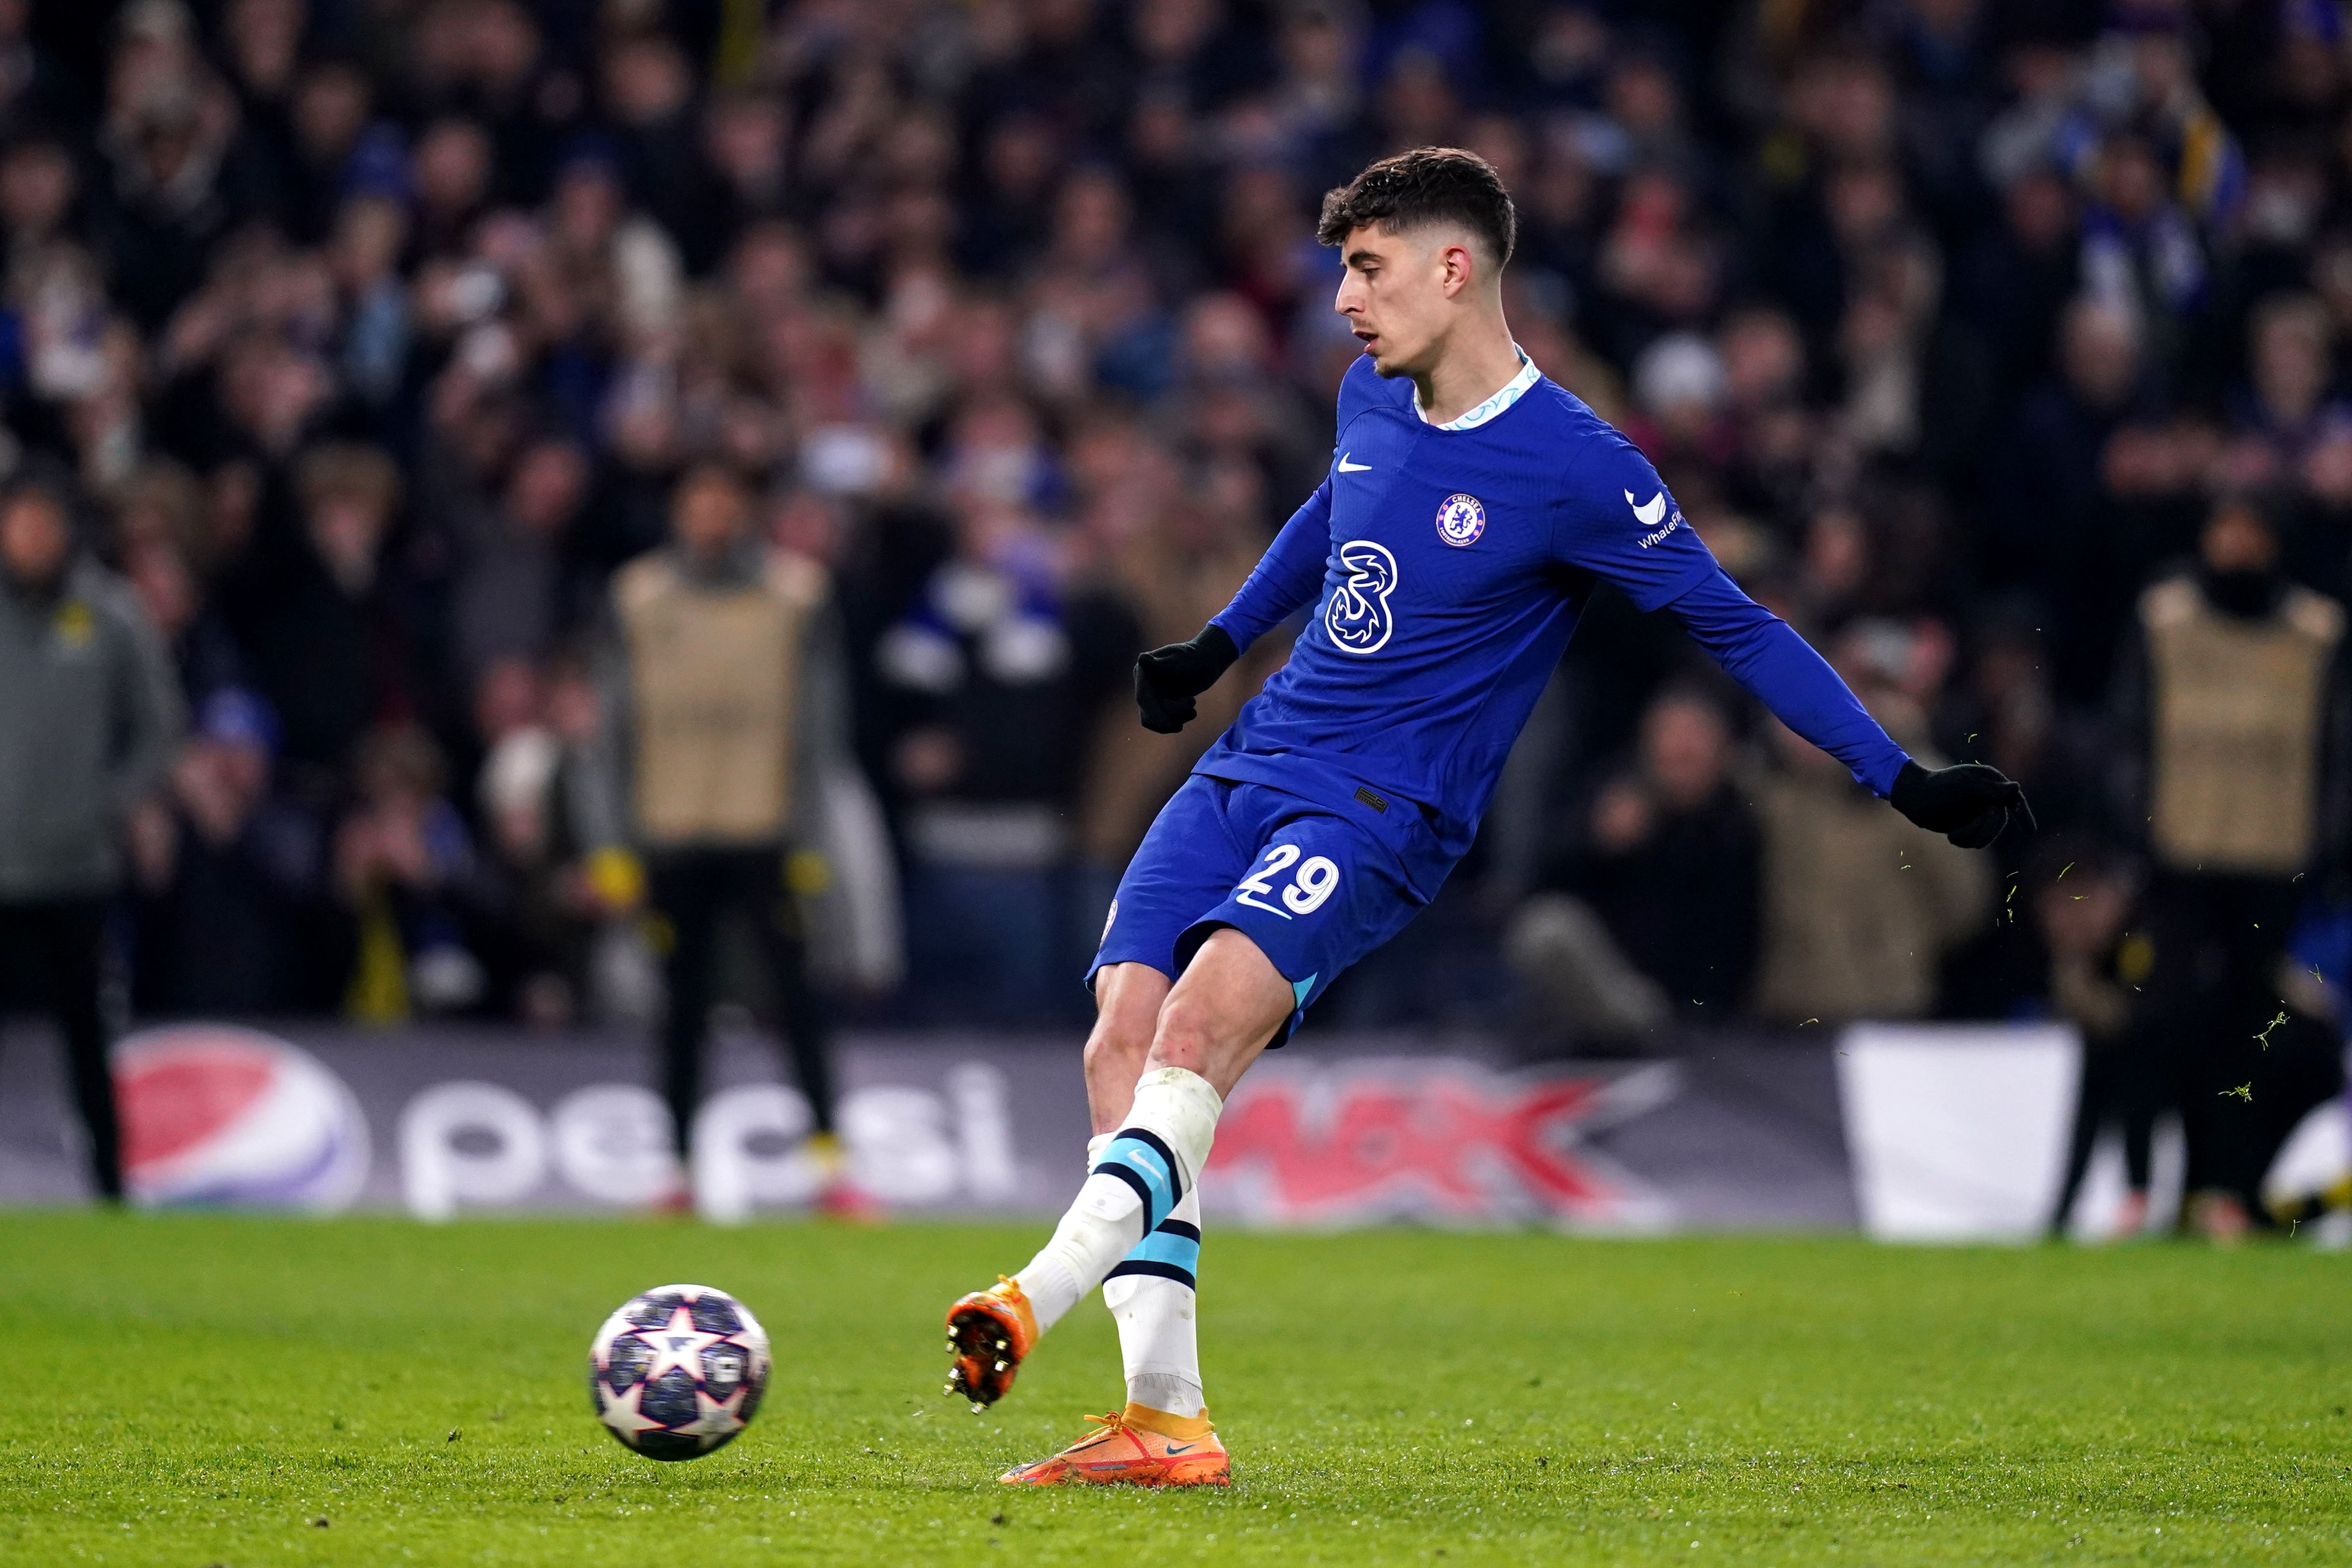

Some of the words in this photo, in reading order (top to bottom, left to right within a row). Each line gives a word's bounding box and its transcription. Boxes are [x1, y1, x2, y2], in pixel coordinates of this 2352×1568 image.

[1452, 495, 1481, 513] CHELSEA
[1325, 540, 1398, 654] 3
[1237, 844, 1339, 915] 29
[400, 1063, 1014, 1225] pepsi
